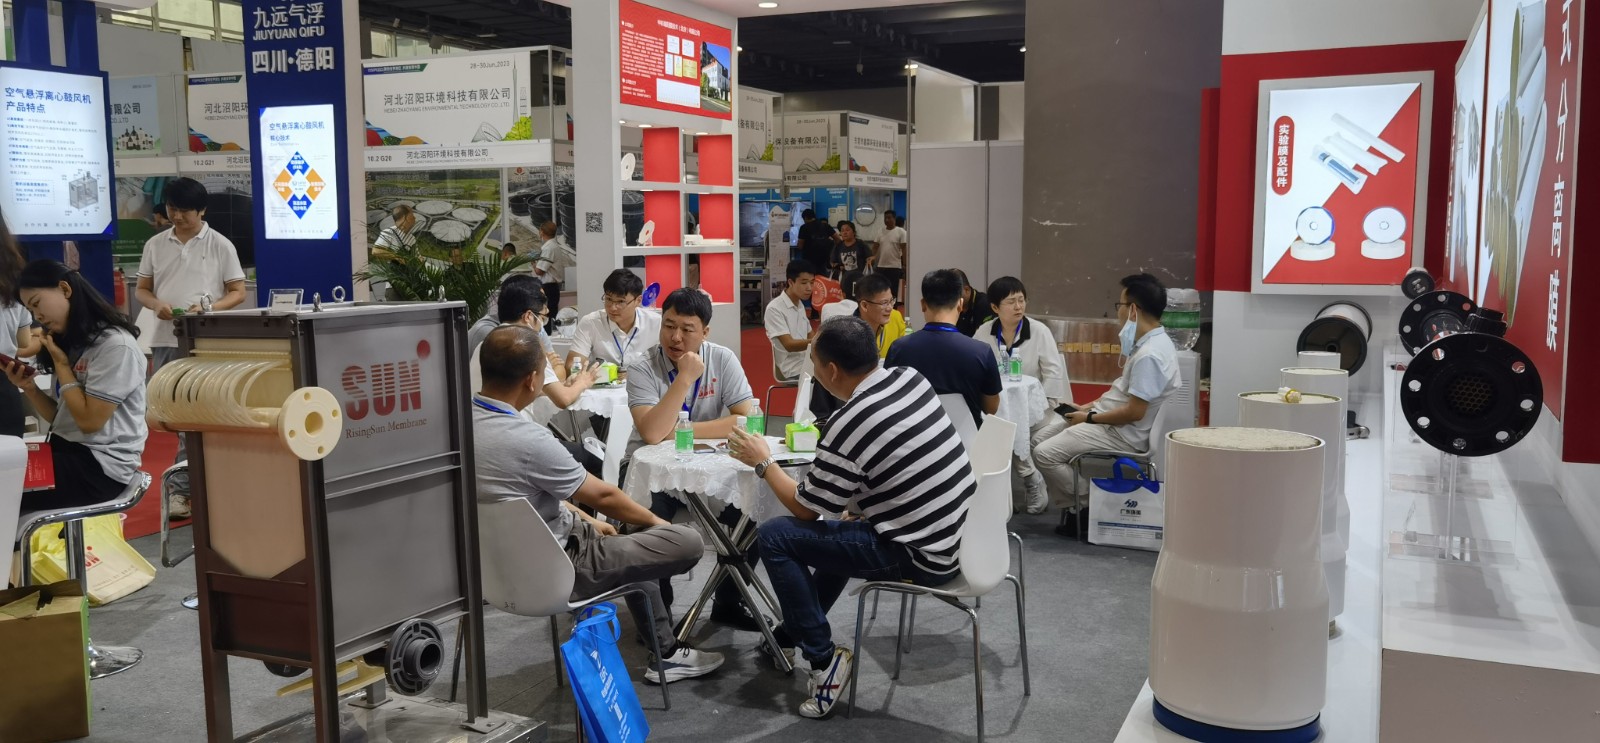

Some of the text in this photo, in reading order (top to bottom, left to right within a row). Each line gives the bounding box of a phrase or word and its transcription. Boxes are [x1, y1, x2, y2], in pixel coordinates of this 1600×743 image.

[252, 2, 325, 29] 九远气浮
[253, 25, 325, 40] JIUYUAN QIFU
[252, 46, 335, 74] 四川·德阳
[4, 86, 92, 105] 空气悬浮离心鼓风机
[383, 87, 511, 106] 河北沼阳环境科技有限公司
[6, 101, 46, 114] 产品特点
[1276, 124, 1290, 188] 实验膜及配件
[341, 360, 422, 420] SUN
[345, 418, 427, 438] RisingSun Membrane
